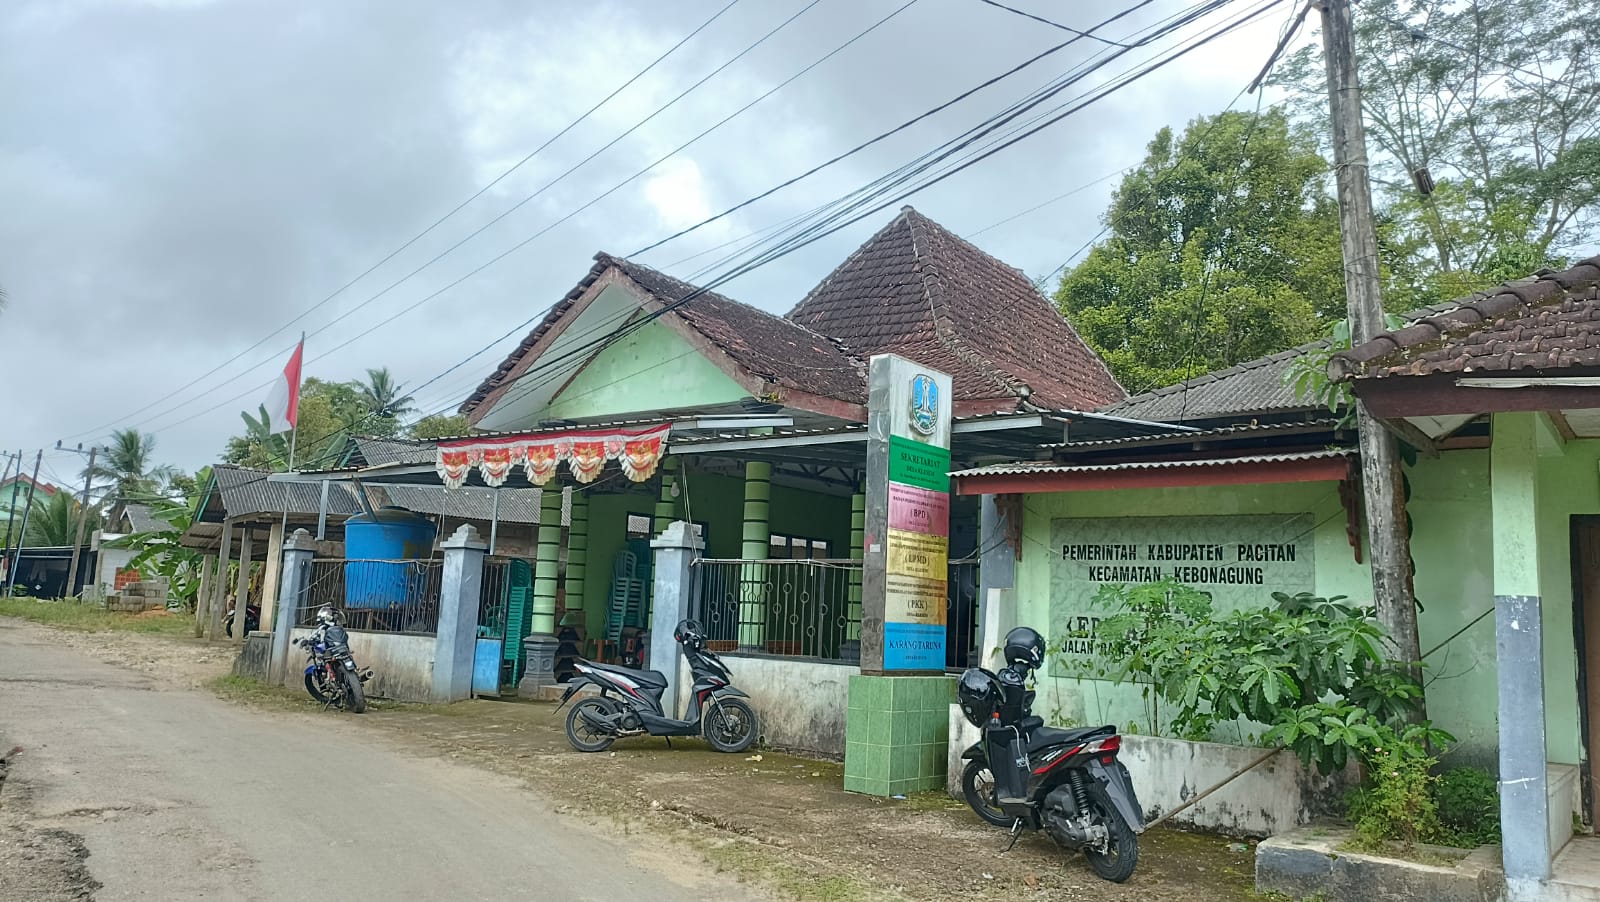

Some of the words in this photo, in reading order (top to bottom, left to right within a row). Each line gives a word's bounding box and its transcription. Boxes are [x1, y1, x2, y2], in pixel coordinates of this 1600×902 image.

[901, 452, 941, 468] SEKRETARIAT
[1062, 544, 1137, 561] PEMERINTAH
[1148, 544, 1224, 561] KABUPATEN
[1237, 544, 1296, 562] PACITAN
[1089, 566, 1161, 582] KECAMATAN
[1174, 566, 1264, 585] KEBONAGUNG
[889, 640, 917, 650] KARANG
[918, 640, 942, 650] TARUNA
[1061, 640, 1094, 655] JALAN
